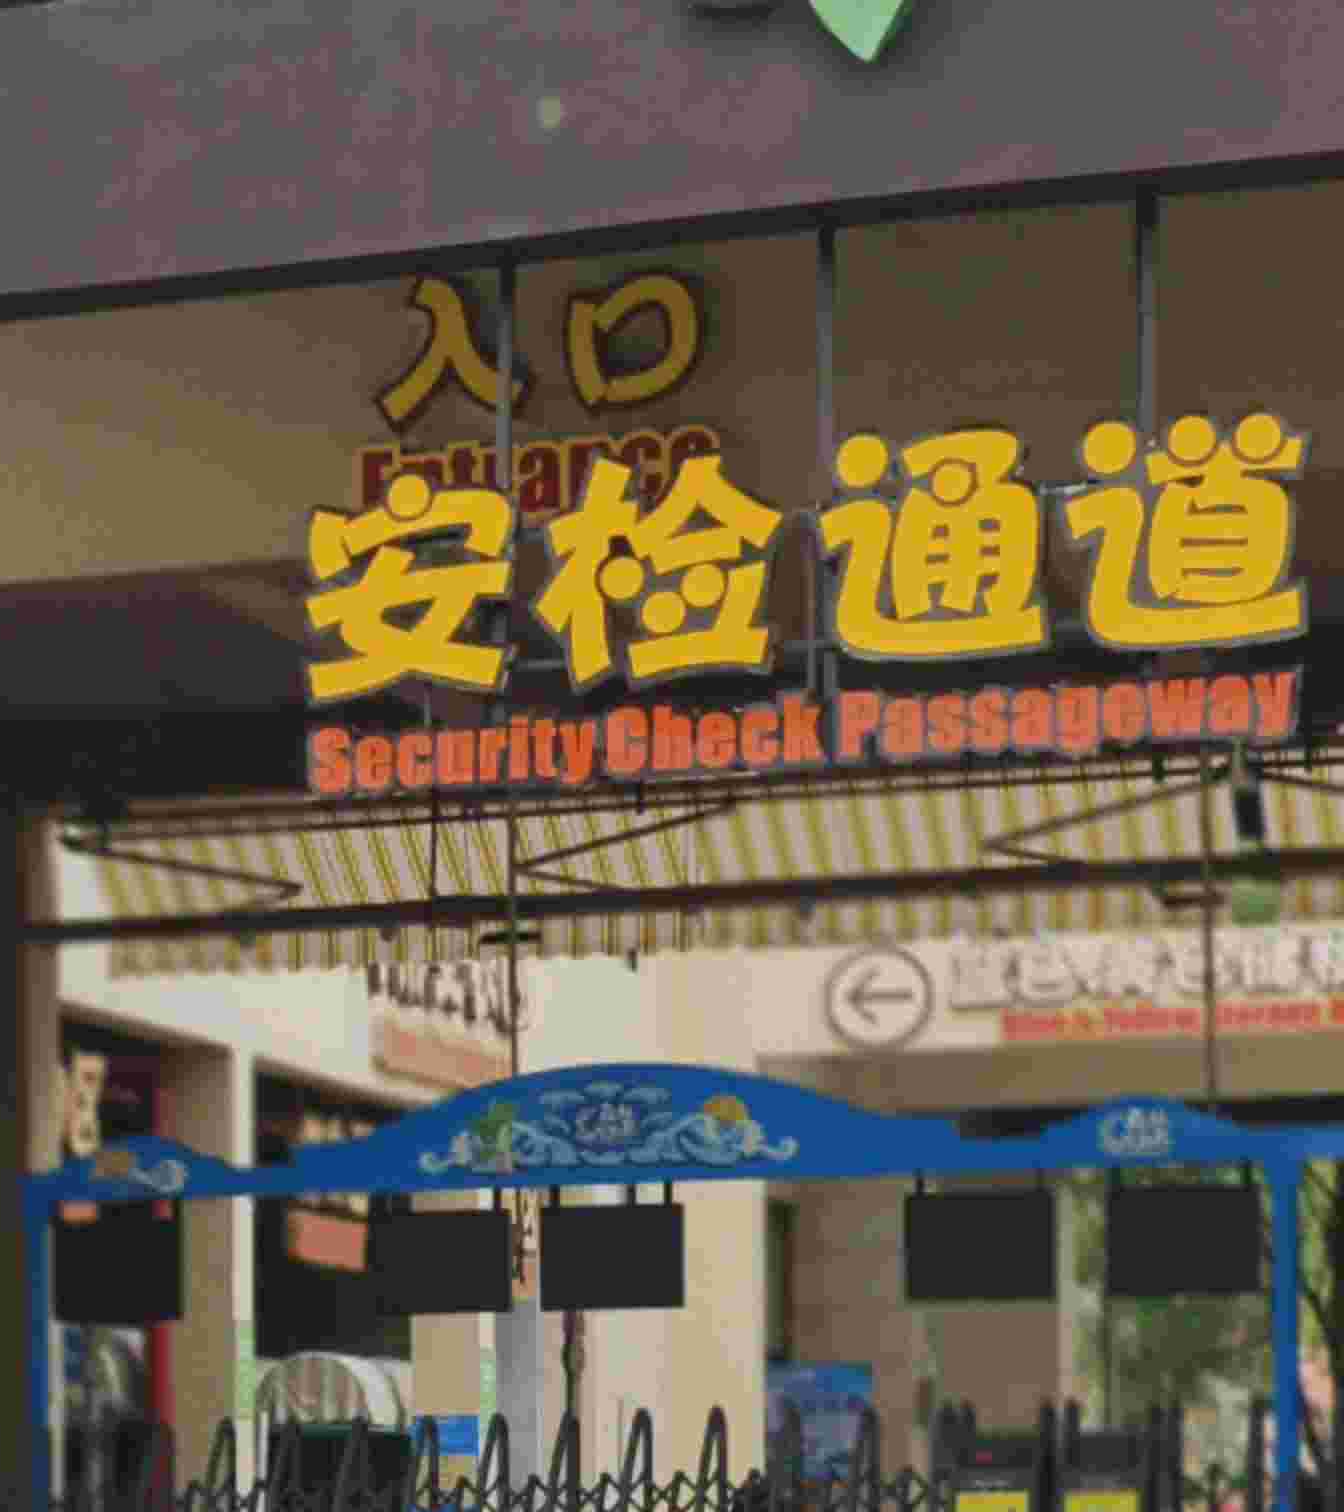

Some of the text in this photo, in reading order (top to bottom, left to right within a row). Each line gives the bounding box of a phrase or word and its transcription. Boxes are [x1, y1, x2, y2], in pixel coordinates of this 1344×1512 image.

[377, 274, 702, 430] 入口
[305, 411, 1310, 704] 安检通道
[310, 669, 1300, 796] Security Check Passageway
